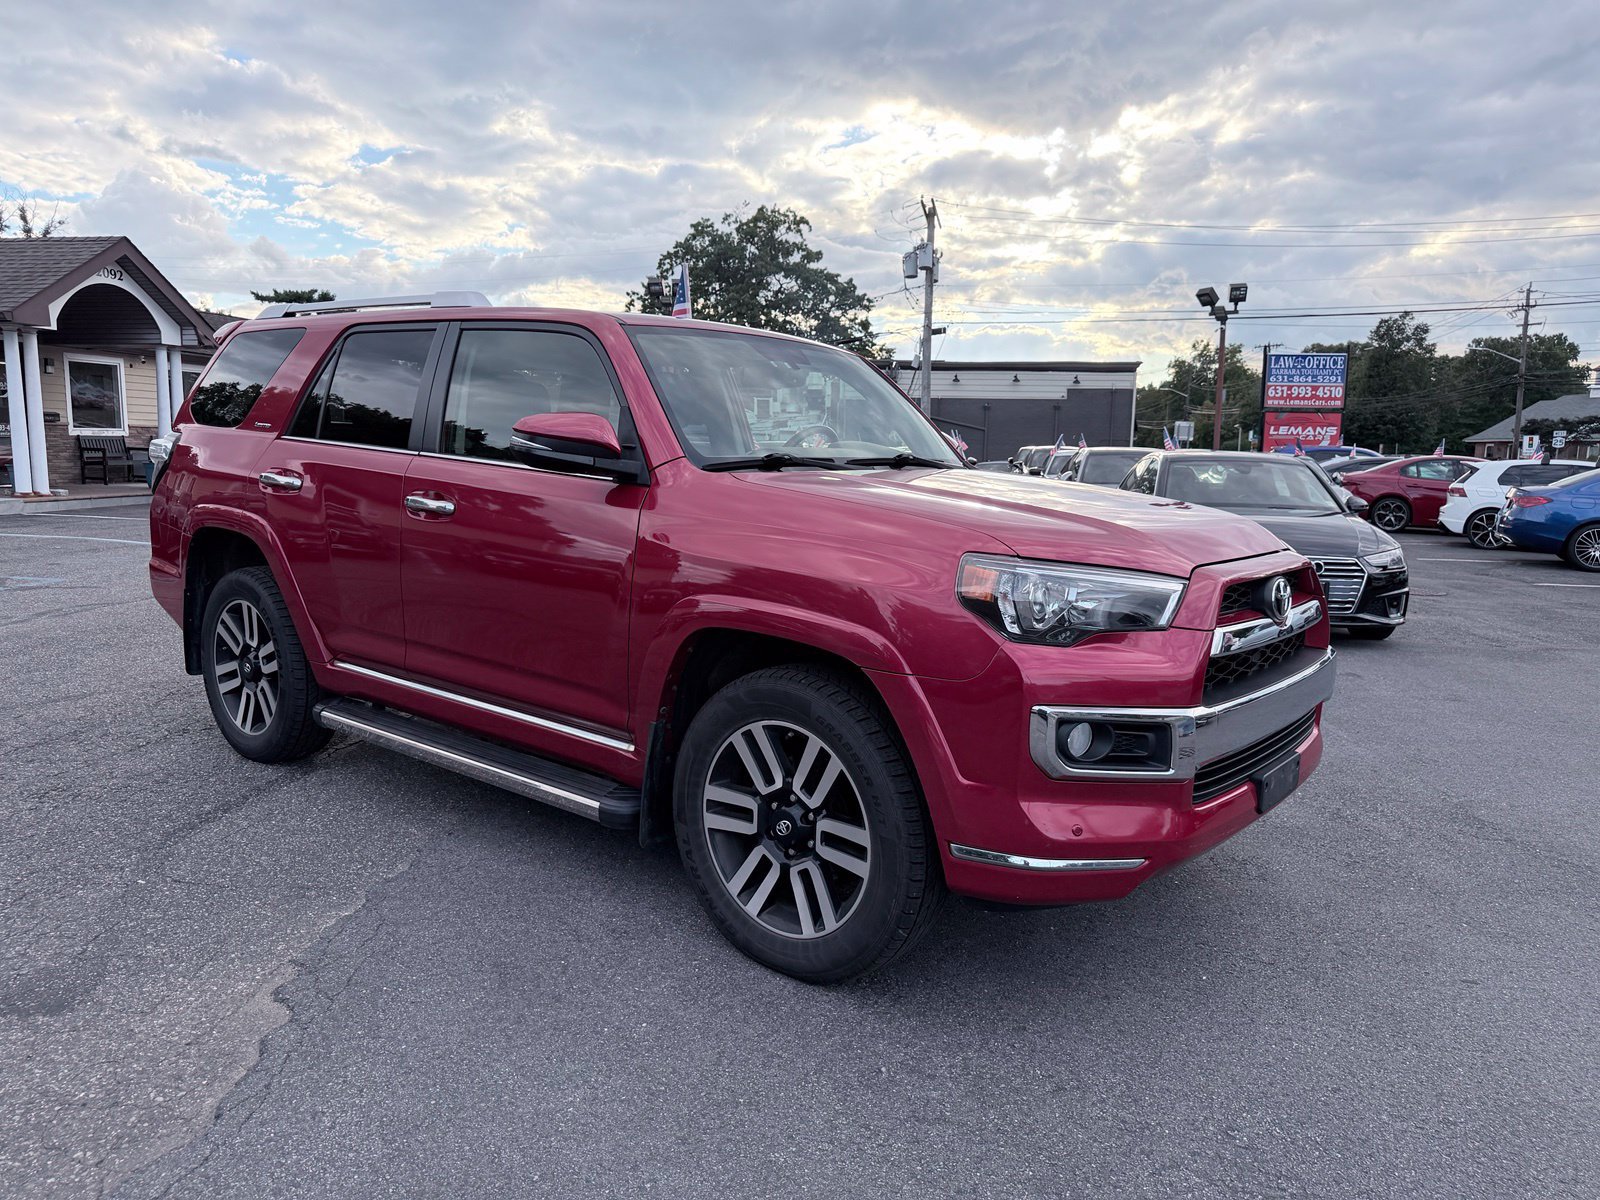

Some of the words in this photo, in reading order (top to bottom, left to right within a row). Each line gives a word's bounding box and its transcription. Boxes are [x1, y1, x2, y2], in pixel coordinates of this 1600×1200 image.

[1271, 356, 1295, 368] LAW
[1305, 356, 1344, 368] OFFICE
[1268, 386, 1342, 397] 631-993-4510
[1269, 426, 1338, 435] LEMANS
[815, 714, 873, 786] GRABBER
